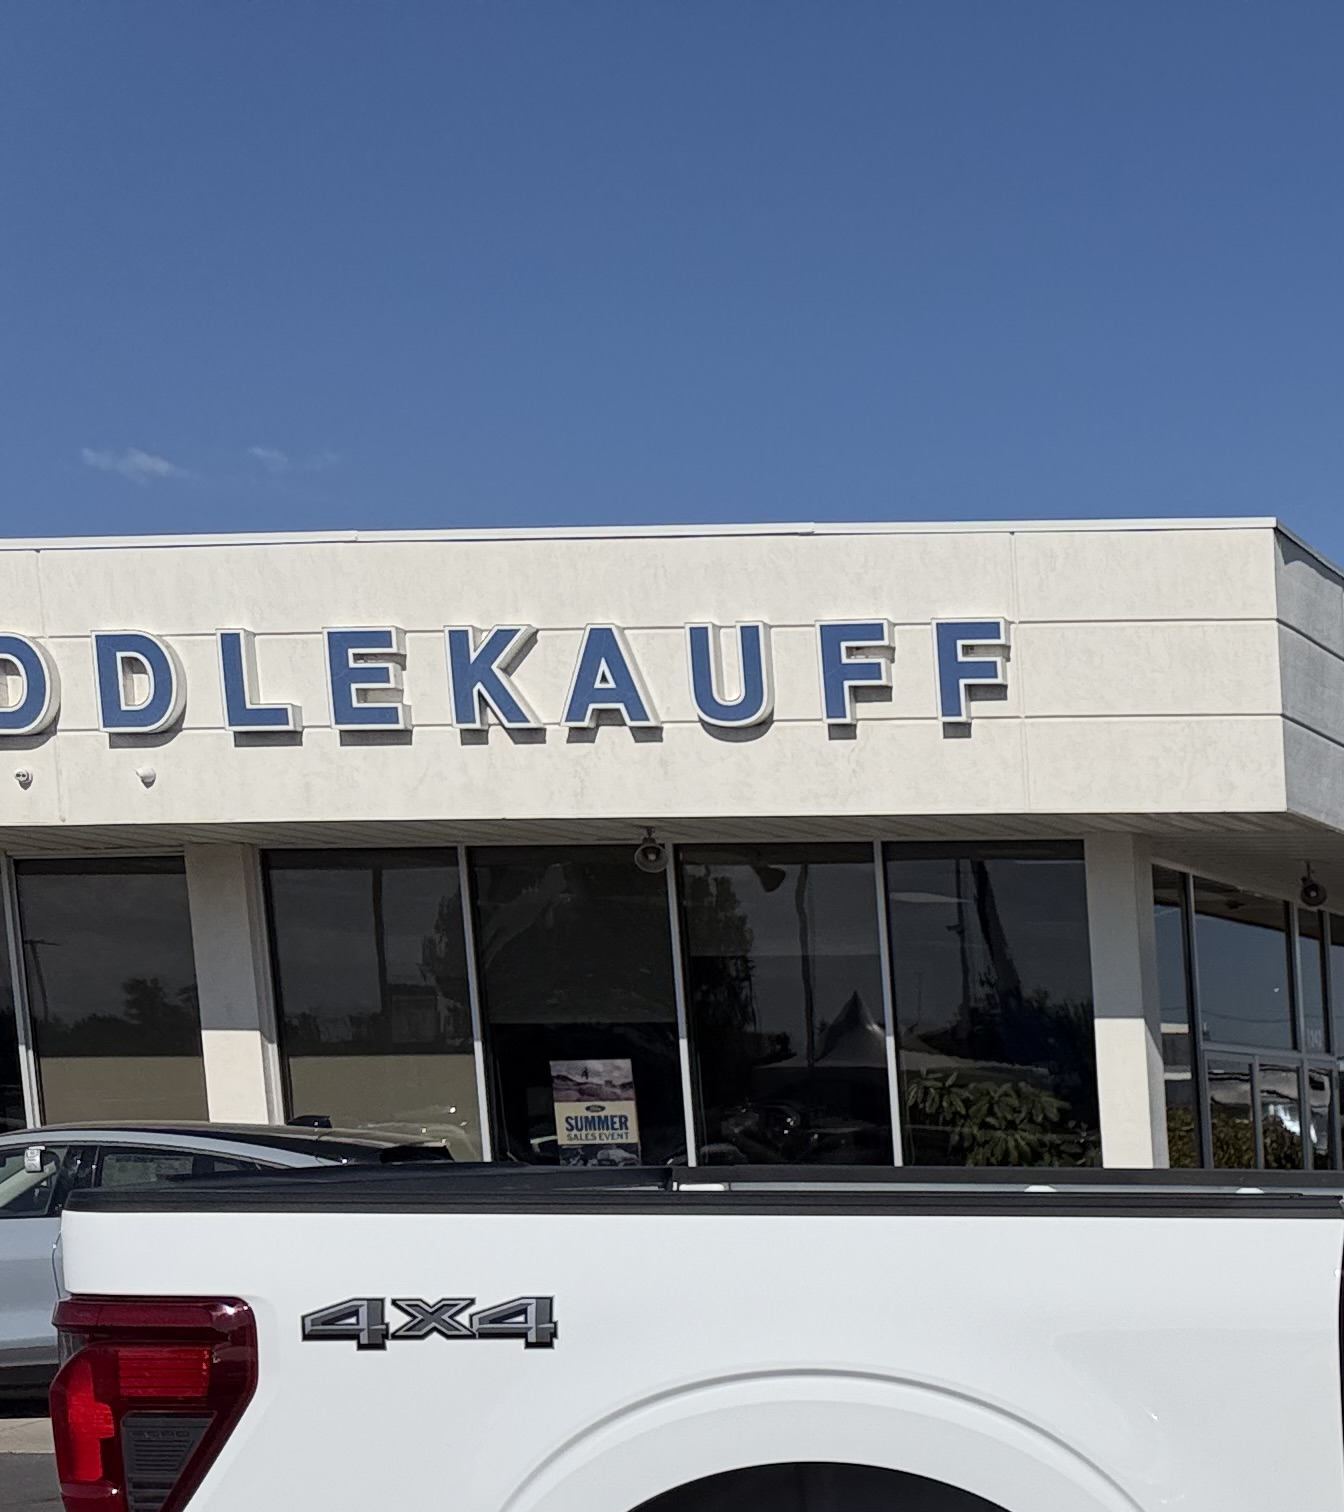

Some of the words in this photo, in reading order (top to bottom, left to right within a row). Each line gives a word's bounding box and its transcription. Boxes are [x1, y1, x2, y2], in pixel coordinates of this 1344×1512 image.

[565, 1114, 629, 1132] SUMMER
[566, 1132, 597, 1142] SALES
[598, 1131, 630, 1141] EVENT
